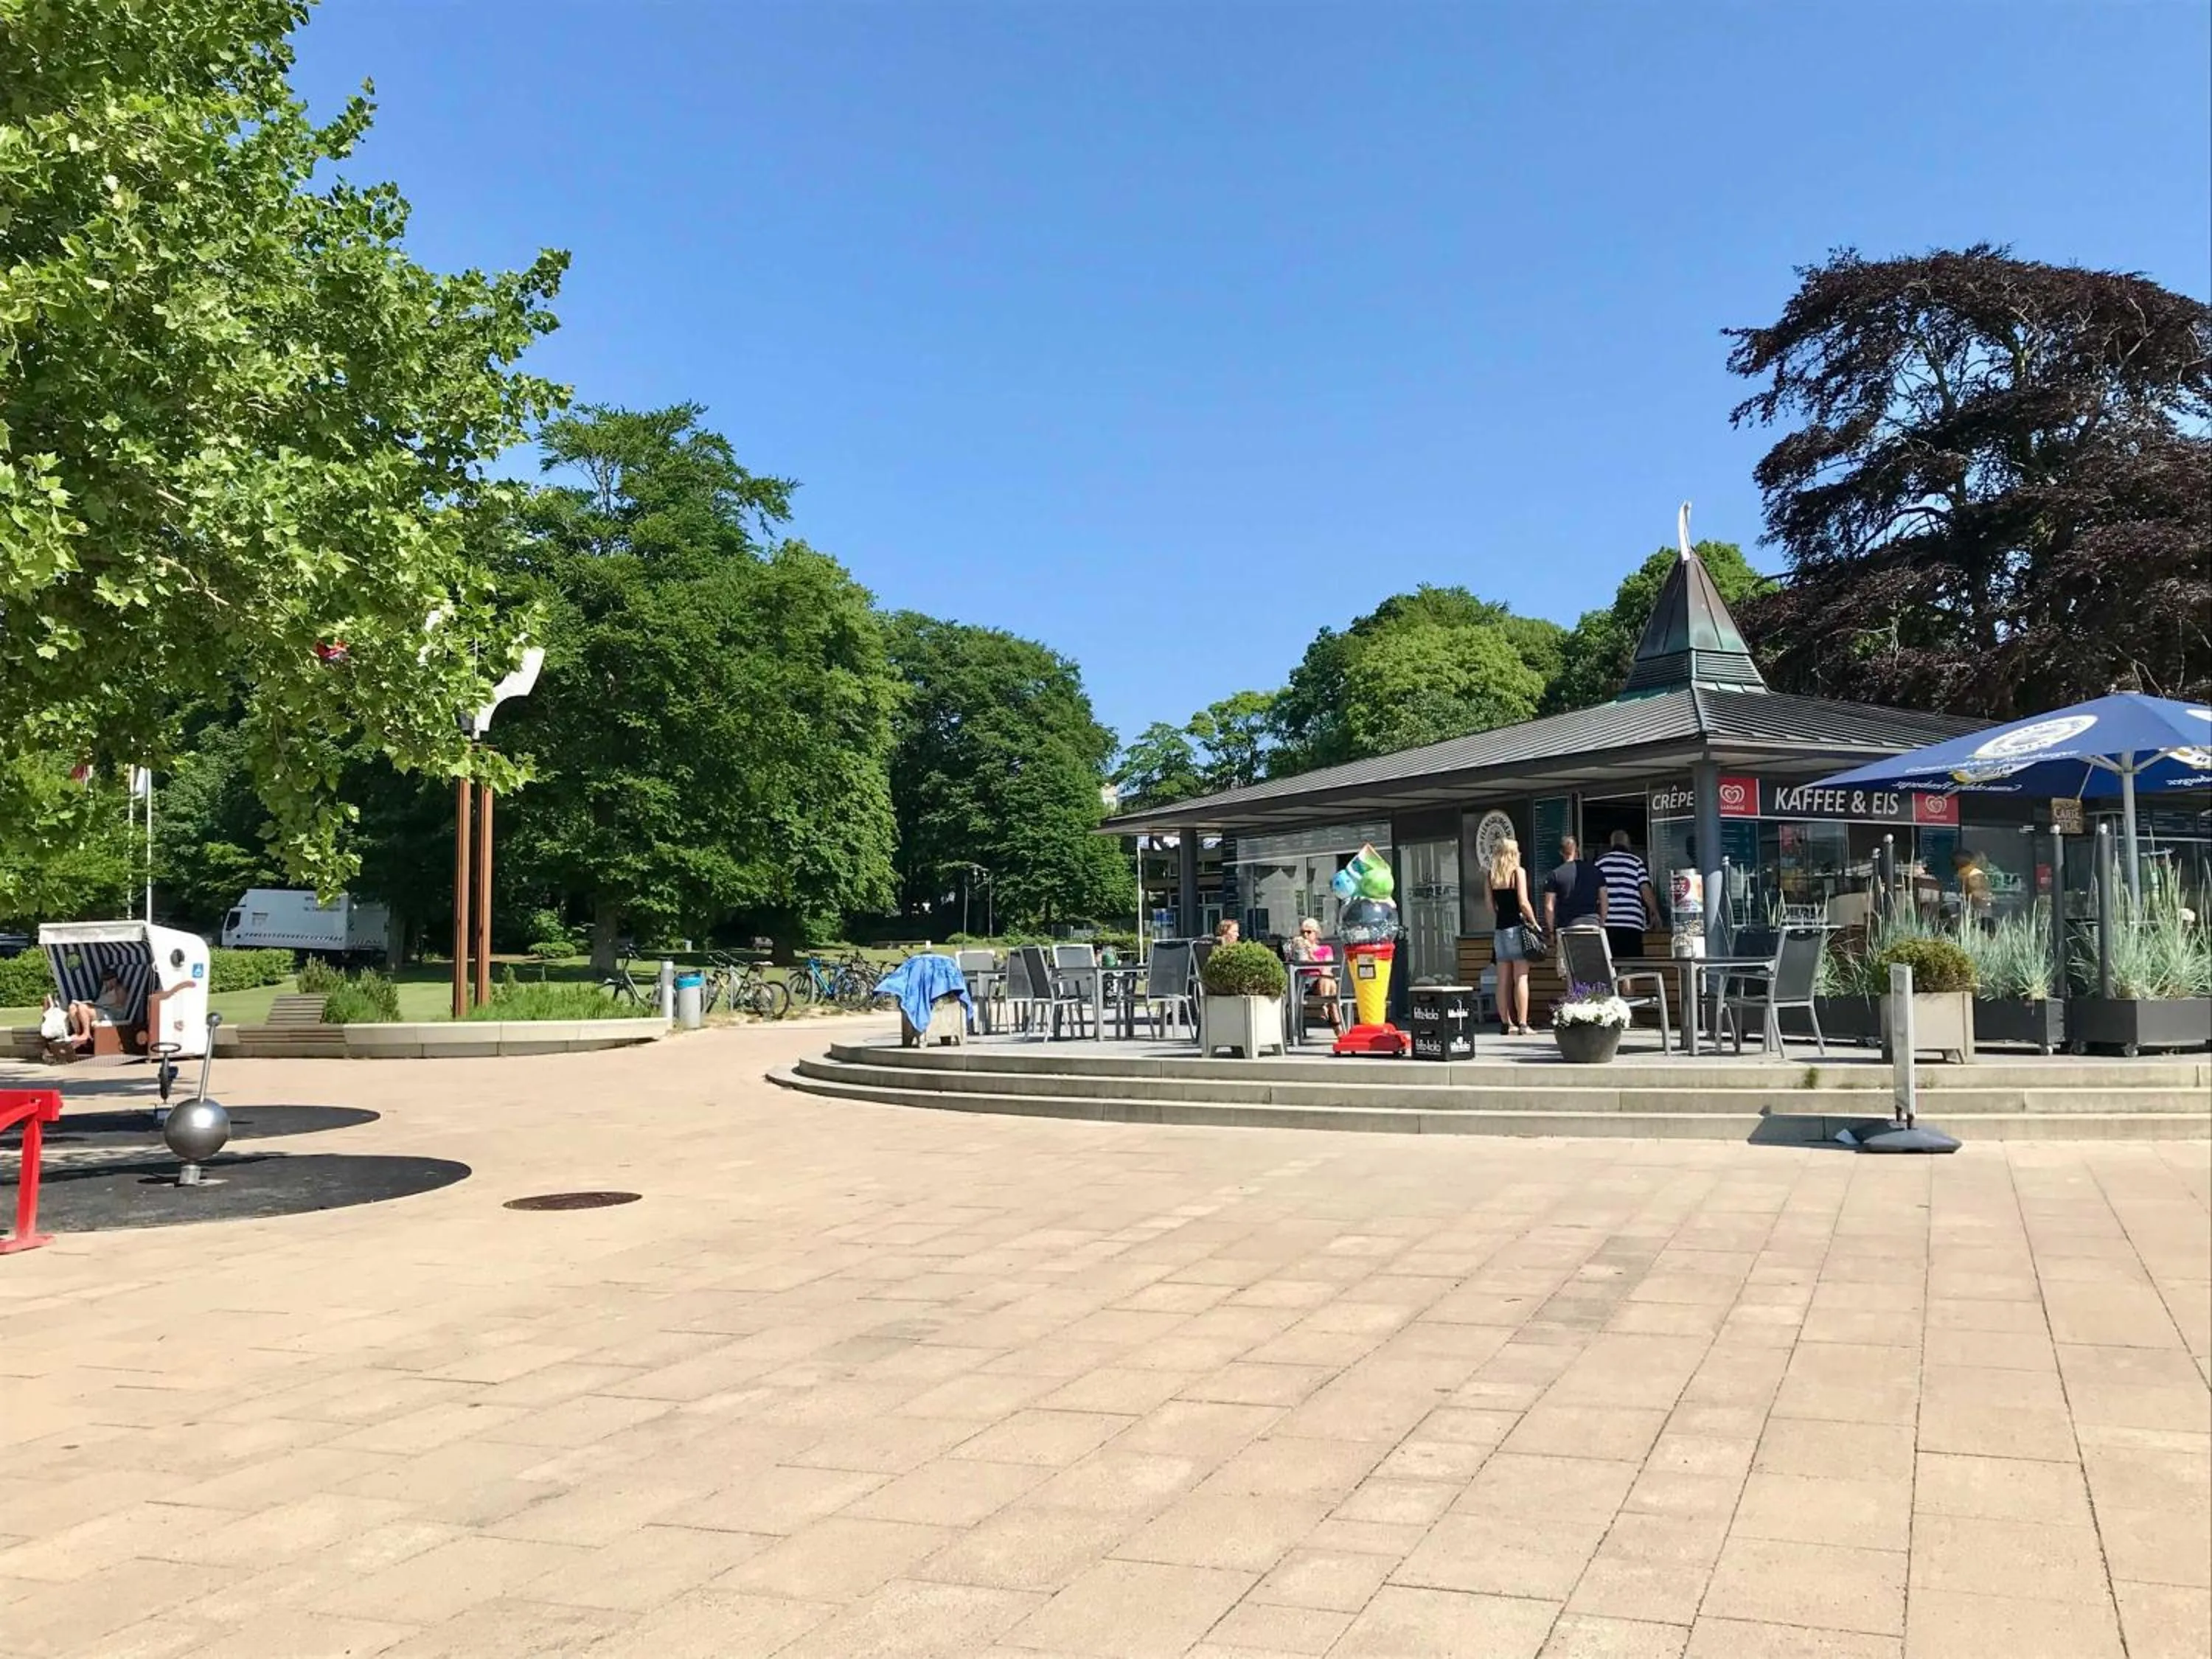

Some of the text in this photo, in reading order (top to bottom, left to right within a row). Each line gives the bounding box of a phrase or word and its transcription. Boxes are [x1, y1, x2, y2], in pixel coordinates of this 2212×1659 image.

[1652, 785, 1694, 810] CRÊPE
[1775, 787, 1899, 815] KAFFEE & EIS
